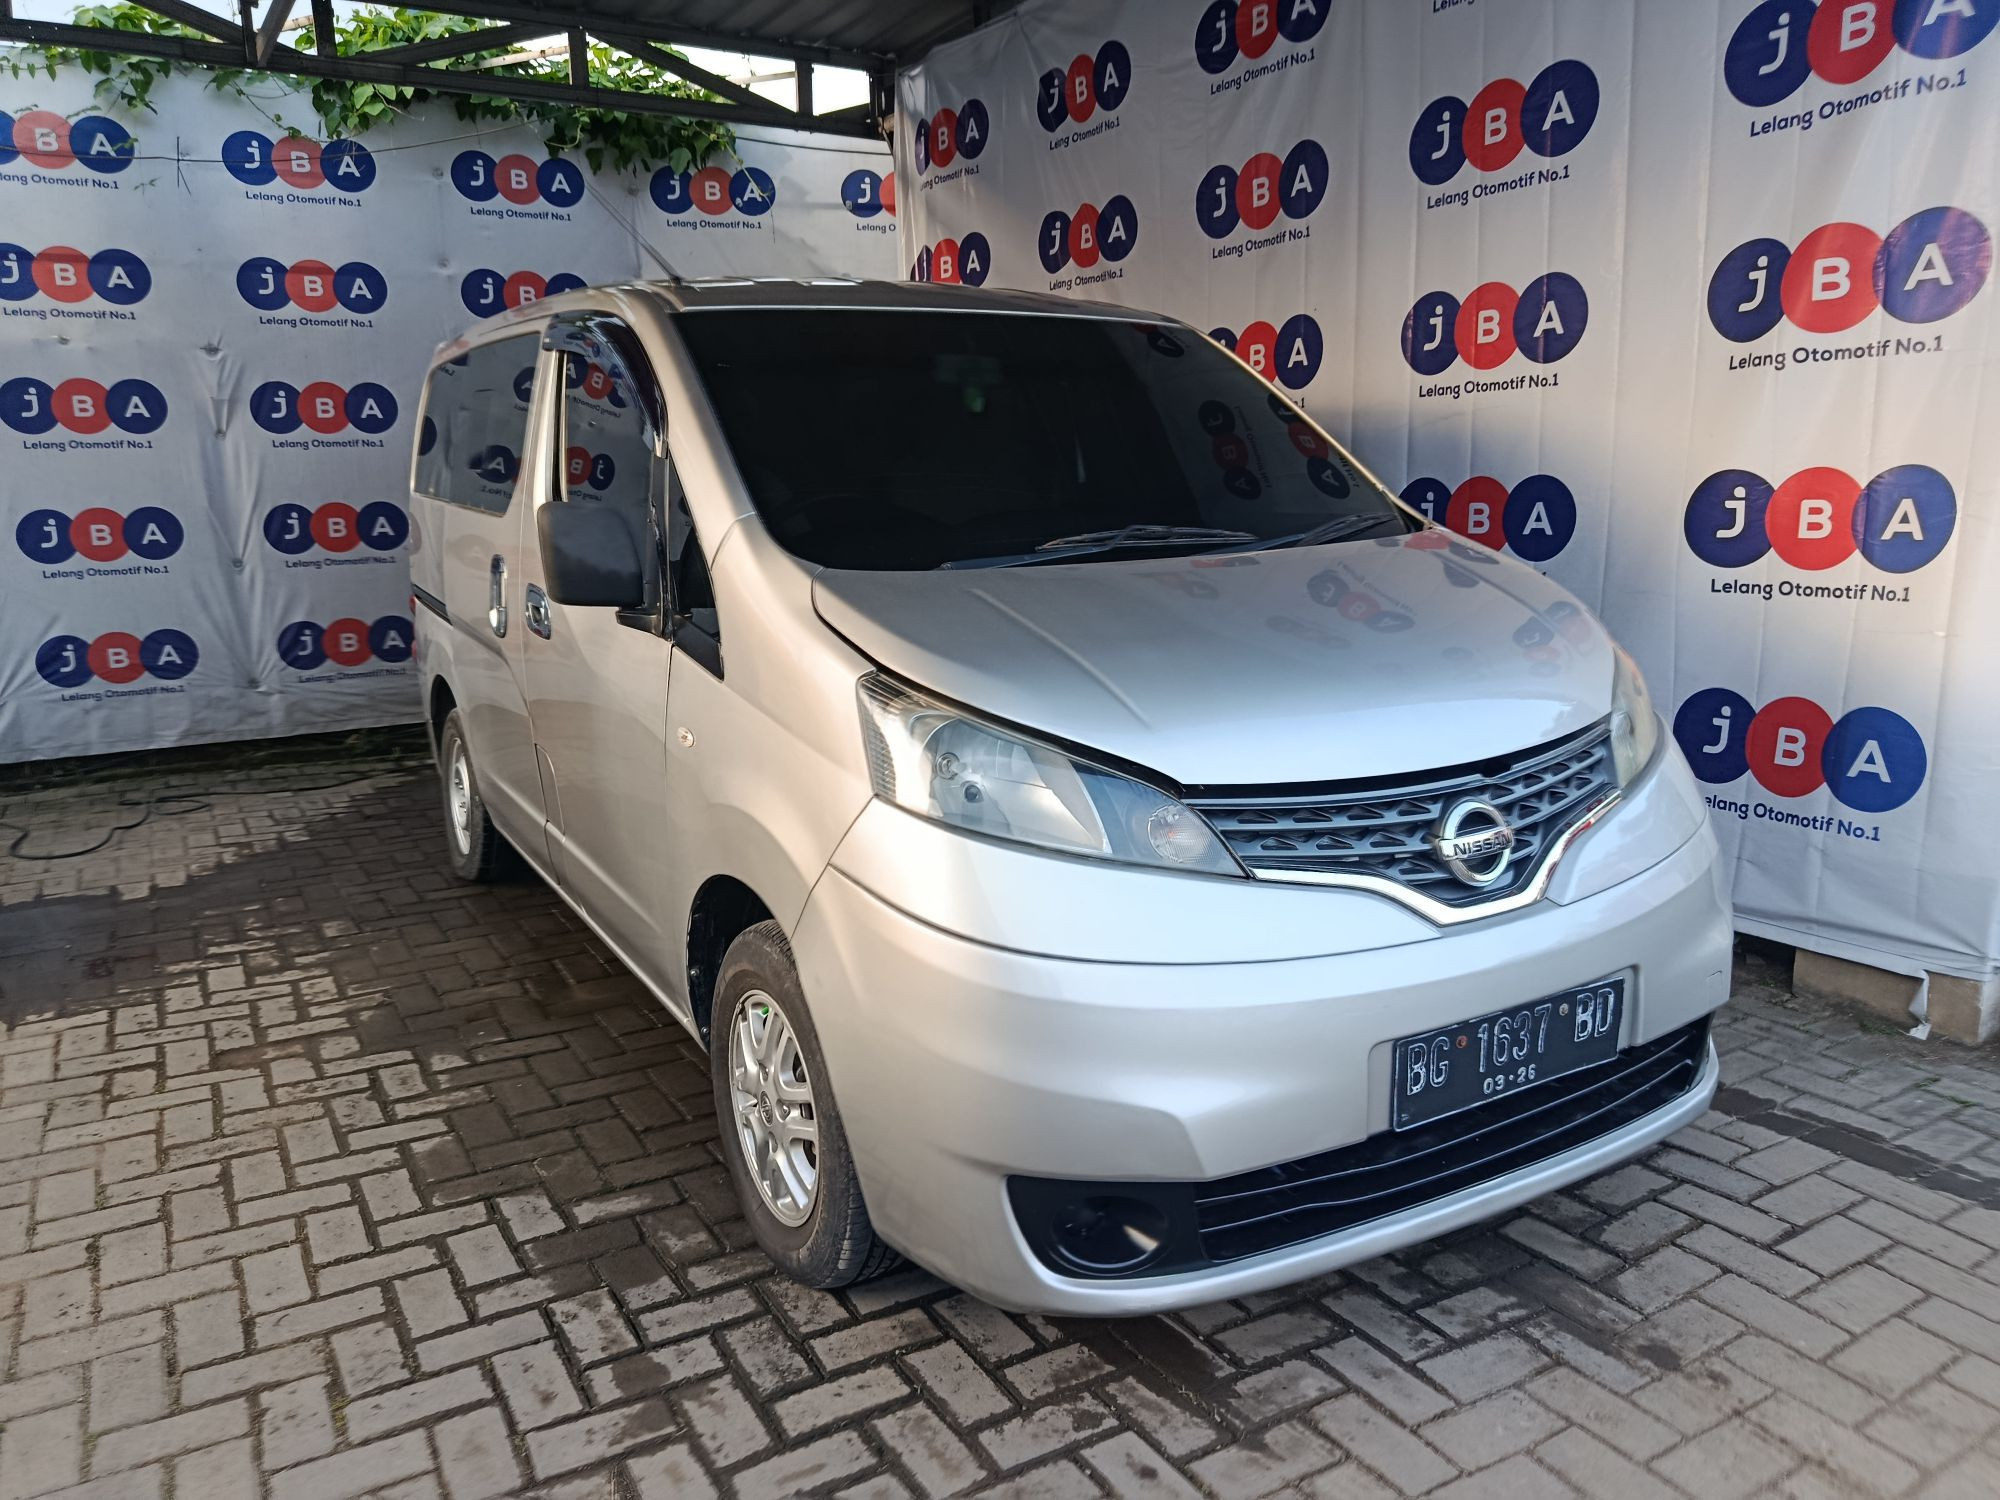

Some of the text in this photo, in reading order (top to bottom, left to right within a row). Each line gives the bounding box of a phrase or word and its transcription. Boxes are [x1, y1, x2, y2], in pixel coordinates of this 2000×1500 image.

[1210, 47, 1315, 96] Lelang Otomotif No.1
[1749, 69, 1967, 138] Lelang Otomotif No.1
[0, 172, 120, 190] lang Otomotif No.1
[1427, 165, 1571, 210] Lelang Otomotif No.1
[246, 191, 362, 207] Lelang Otomotif No.1
[470, 207, 572, 222] Lelang Otomotif No.1
[667, 219, 762, 230] Lelang Otomotif No.1
[856, 223, 888, 234] Lelang
[1212, 226, 1311, 259] Lelang Otomotif No.1
[1050, 268, 1124, 291] Lelang Otomotif No.1
[3, 307, 137, 321] Lelang Otomotif No.1
[259, 316, 373, 328] Lelang Otomotif No.1
[1729, 335, 1944, 371] Lelang Otomotif No.1
[1419, 373, 1560, 399] Lelang Otomotif No.1
[23, 439, 153, 452] Lelang Otomotif No.1
[272, 439, 385, 451] Lelang Otomotif No.1
[42, 564, 170, 580] Lelang Otomotif No.1
[285, 555, 397, 570] Lelang Otomotif No.1
[1710, 578, 1911, 603] Lelang Otomotif No.1
[61, 684, 186, 703] Lelang Otomotif No.1
[1705, 795, 1881, 842] elang Otomotif No.1
[1452, 831, 1512, 857] NISSAN
[1407, 987, 1615, 1096] BG 1637 BD
